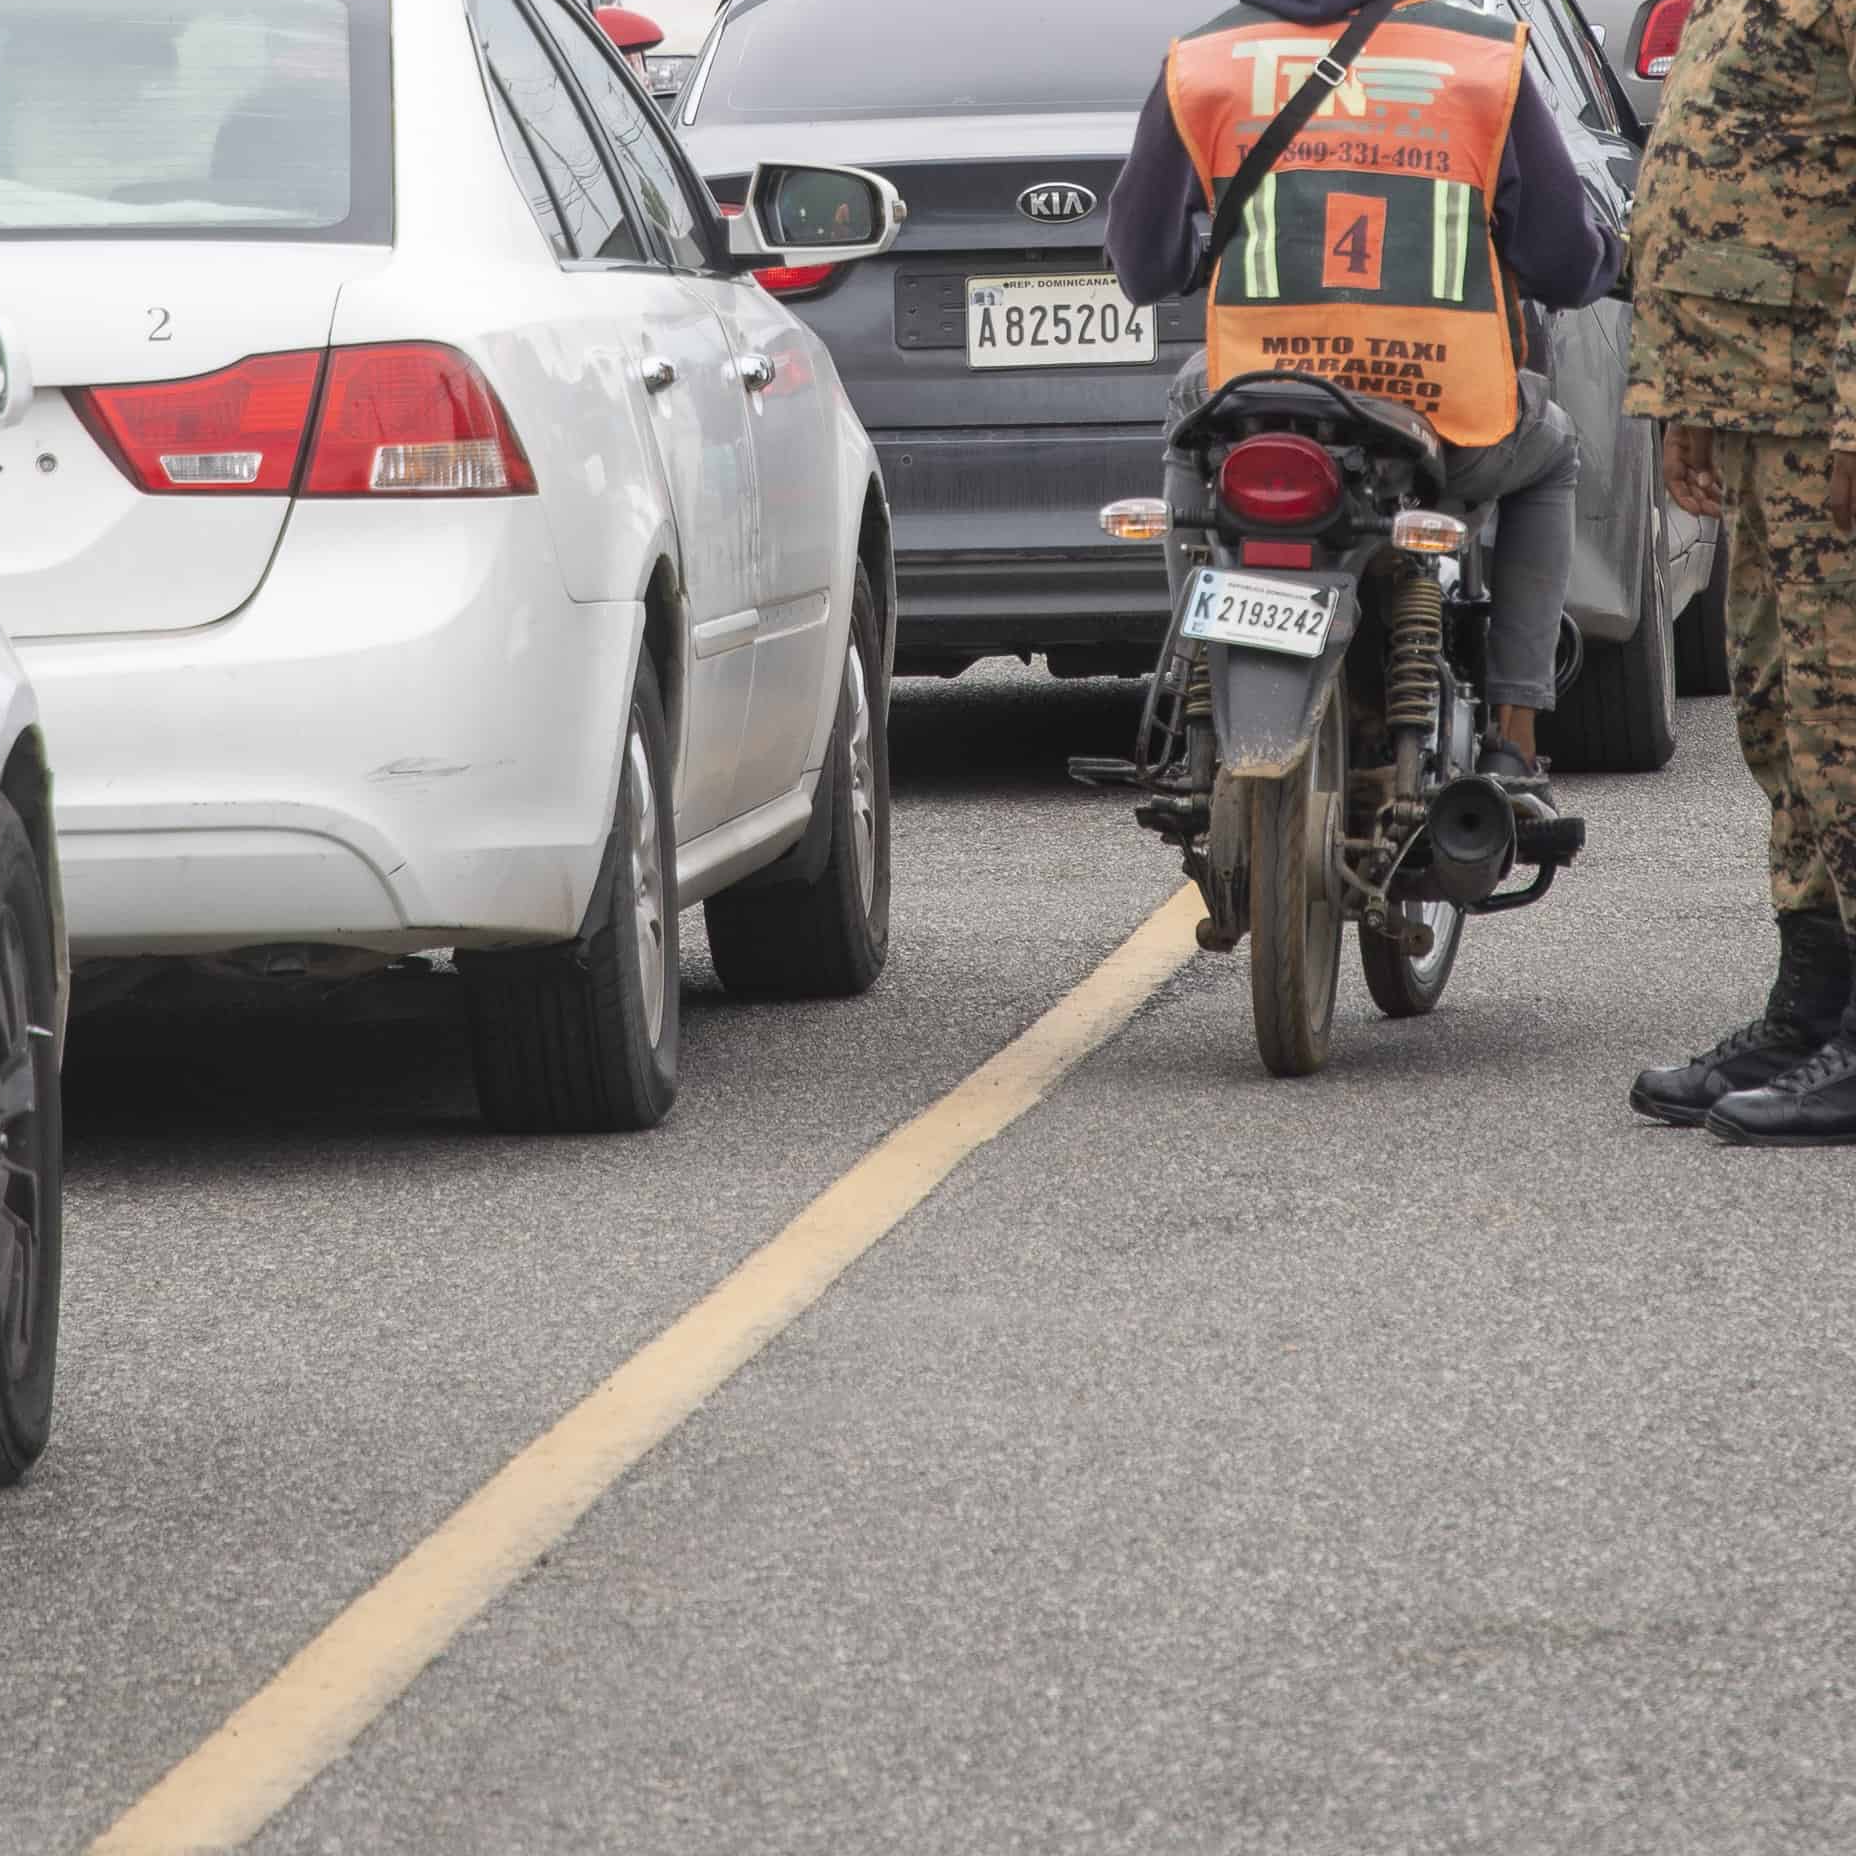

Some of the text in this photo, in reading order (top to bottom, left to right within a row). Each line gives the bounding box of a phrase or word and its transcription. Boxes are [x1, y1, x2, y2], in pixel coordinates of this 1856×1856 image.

[1029, 192, 1084, 216] KIA
[1333, 215, 1371, 274] 4
[1009, 278, 1110, 289] REP. DOMINICANA
[147, 307, 173, 341] 2
[978, 303, 1143, 348] A825204
[1262, 337, 1447, 361] MOTO TAXI
[1274, 358, 1424, 379] PARADA
